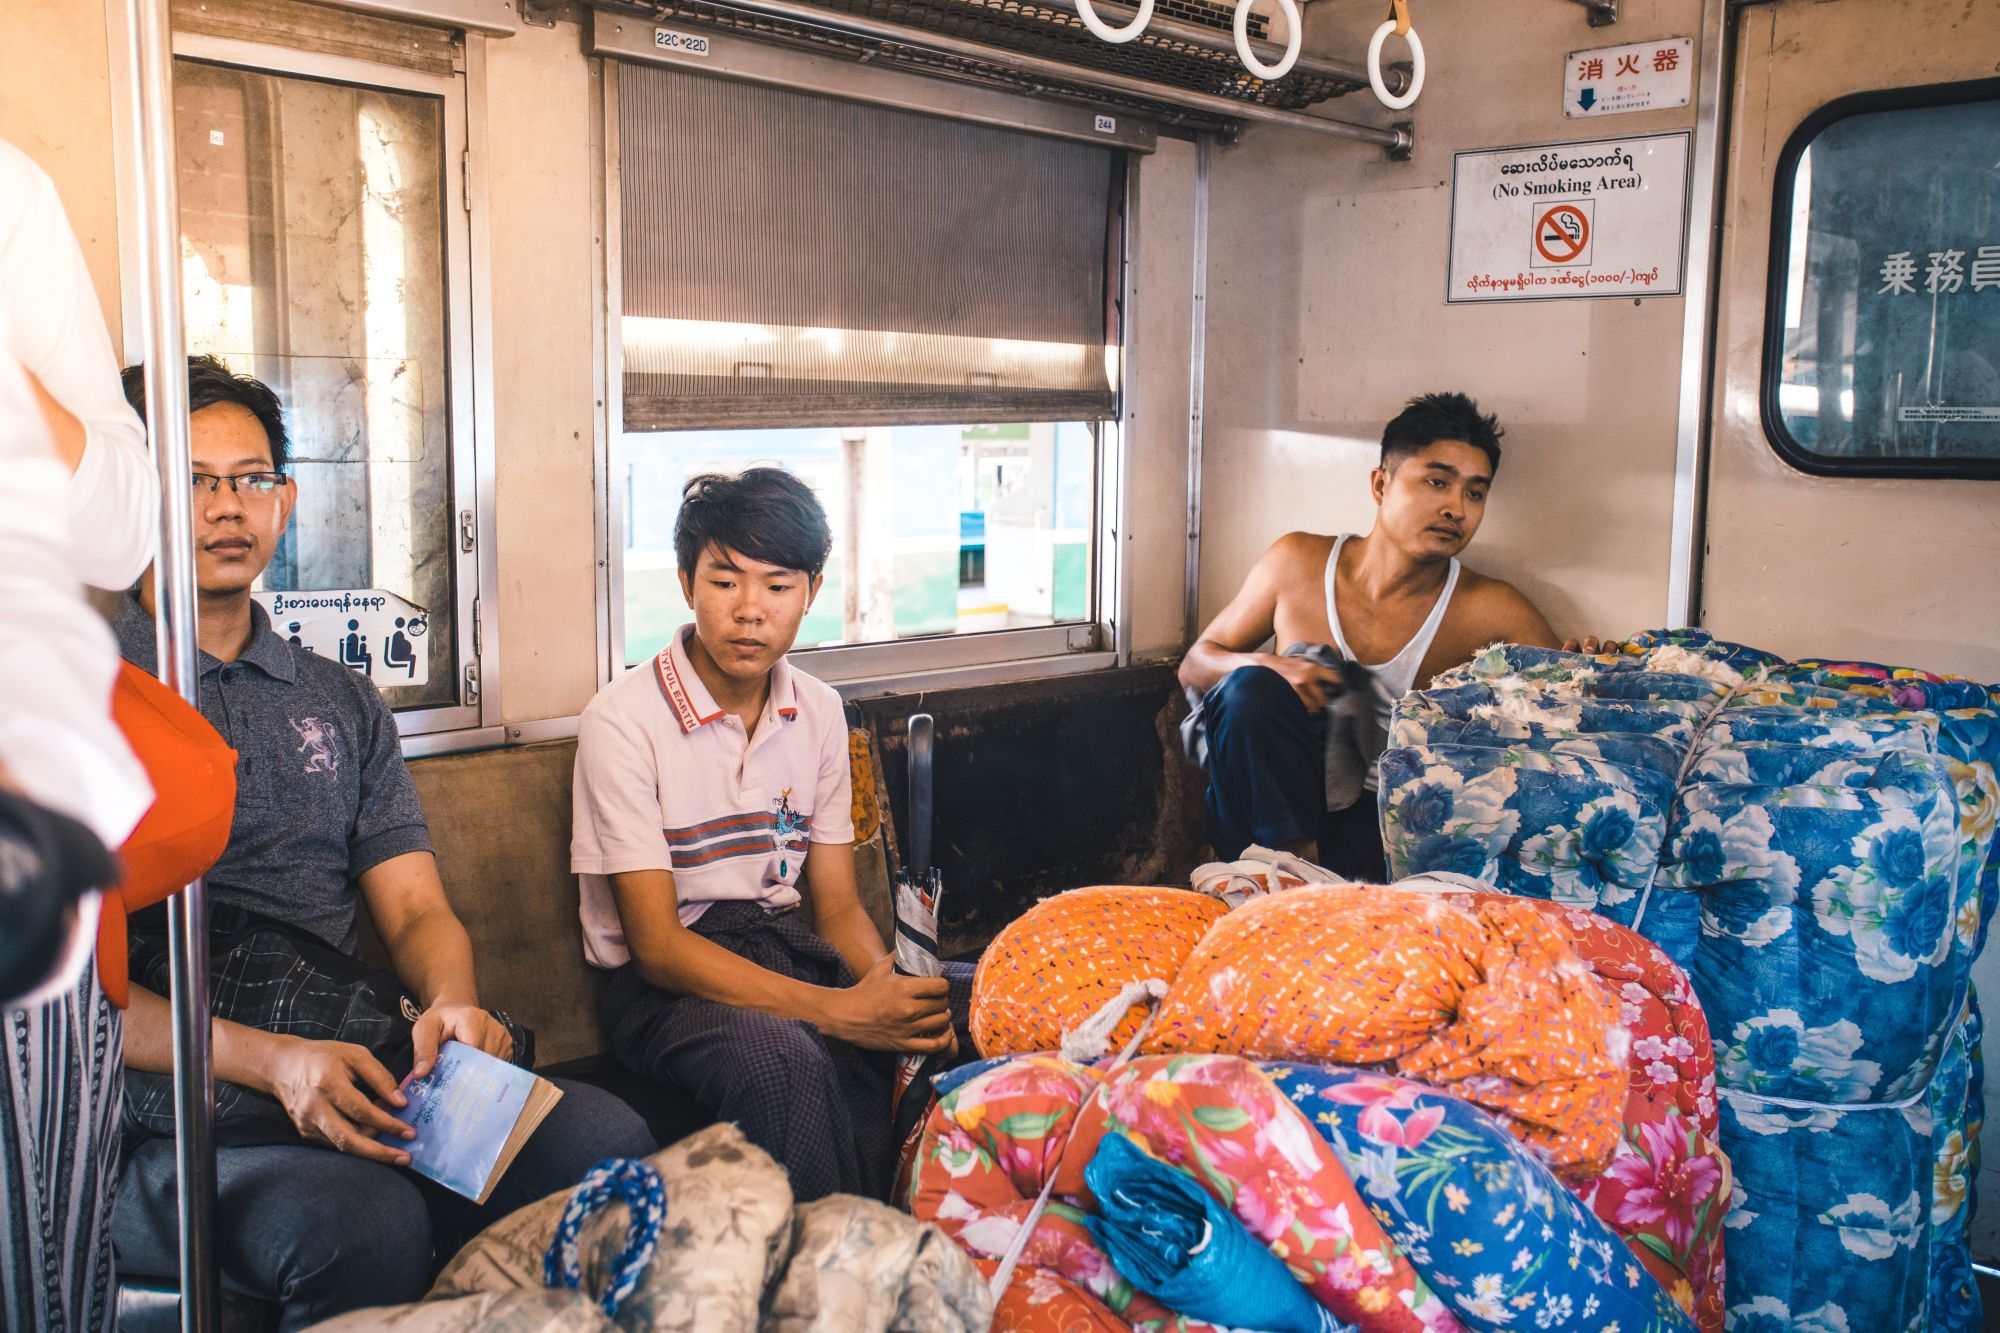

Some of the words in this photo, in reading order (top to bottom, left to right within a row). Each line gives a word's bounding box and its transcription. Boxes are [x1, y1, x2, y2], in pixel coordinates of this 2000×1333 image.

[657, 32, 679, 47] 22C
[685, 37, 707, 52] 22D
[1578, 48, 1680, 80] 消火器
[1501, 147, 1634, 175] ဆေးလိပ်မသောက်ရ
[1493, 182, 1519, 200] (No
[1523, 178, 1592, 195] Smoking
[1596, 173, 1642, 192] Area)
[1878, 245, 2000, 296] 乗務員
[673, 690, 697, 729] EARTH
